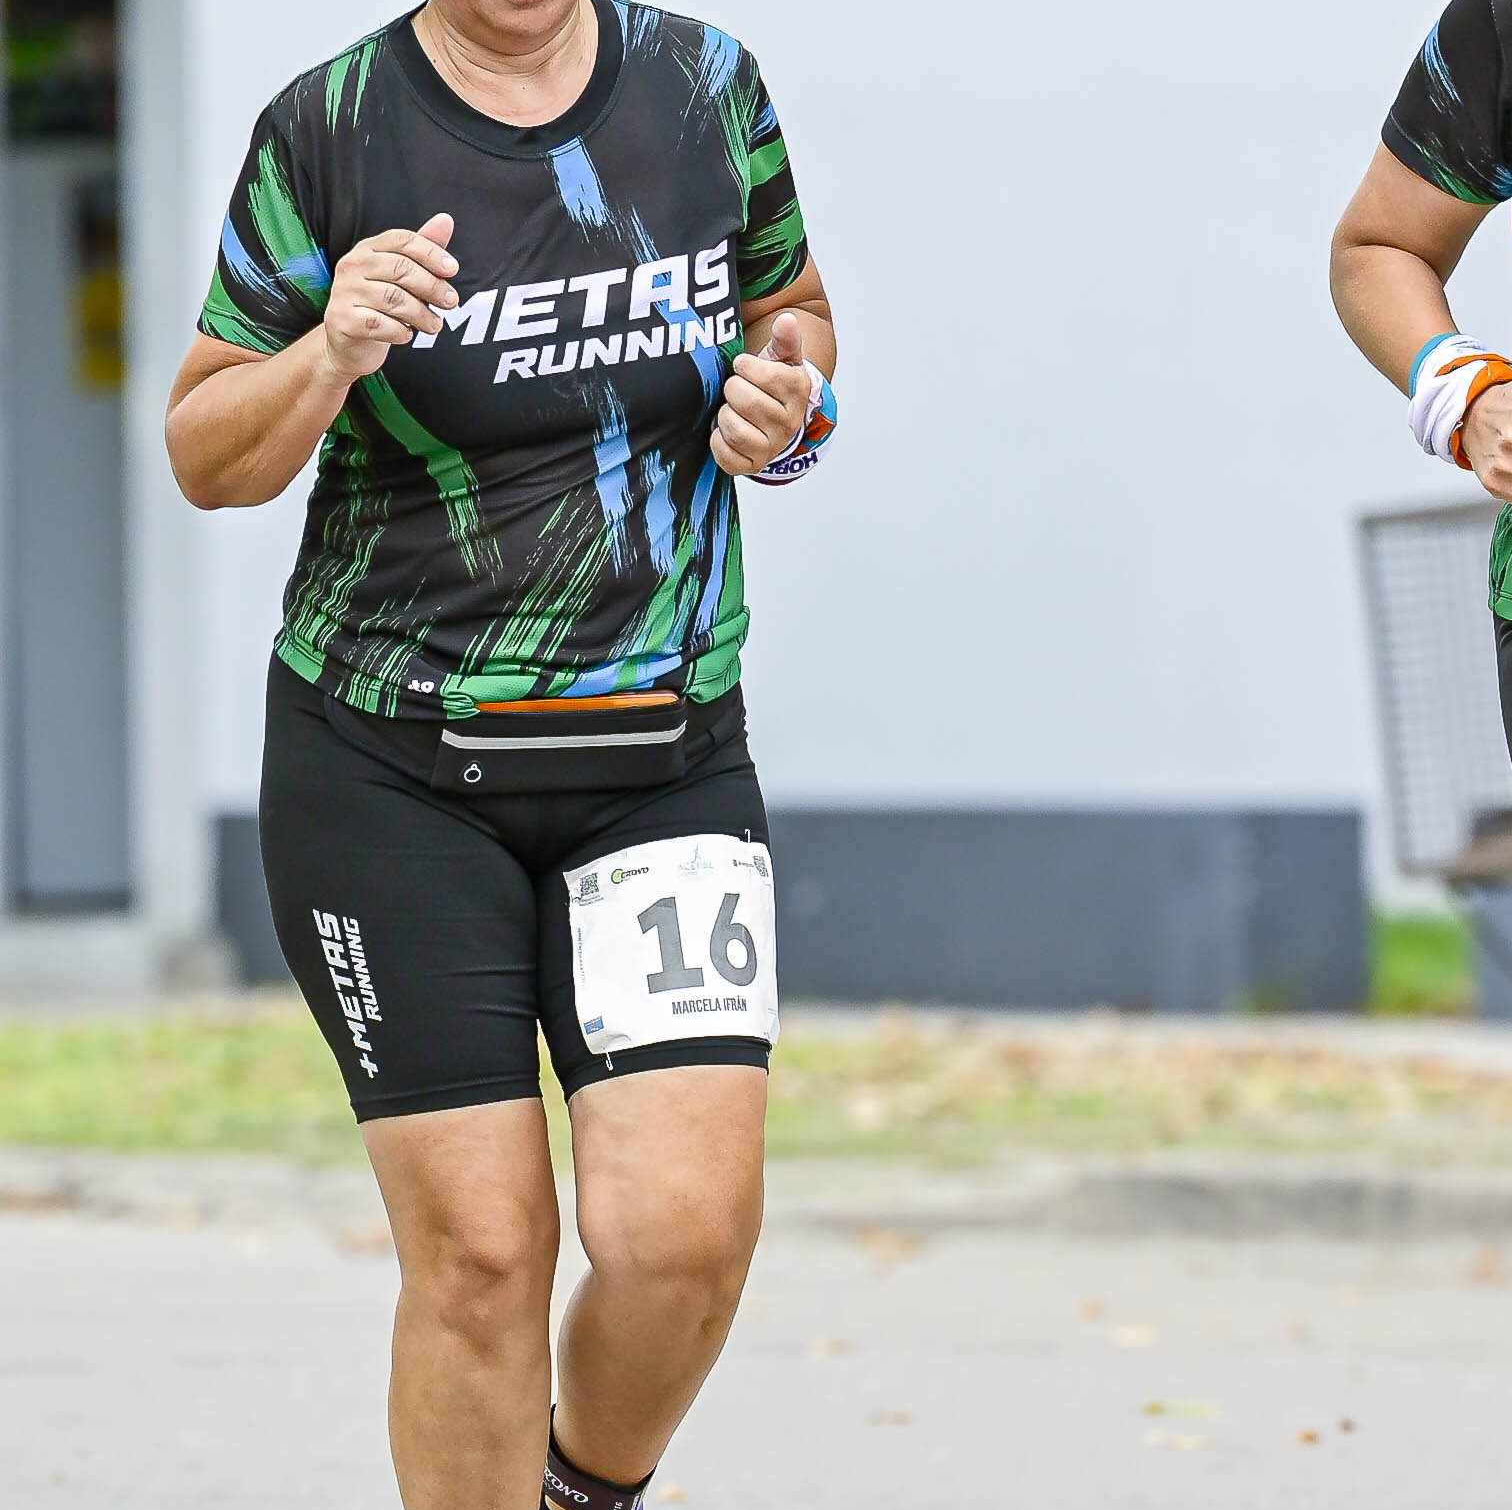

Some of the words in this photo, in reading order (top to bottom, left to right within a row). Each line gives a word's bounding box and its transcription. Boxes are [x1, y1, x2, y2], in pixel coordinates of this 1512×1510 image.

[493, 306, 736, 384] RUNNING
[312, 908, 379, 1079] +METAS
[342, 916, 383, 1022] RUNNING
[637, 893, 758, 995] 16
[671, 998, 722, 1015] MARCELA
[723, 994, 748, 1012] IFRÁN
